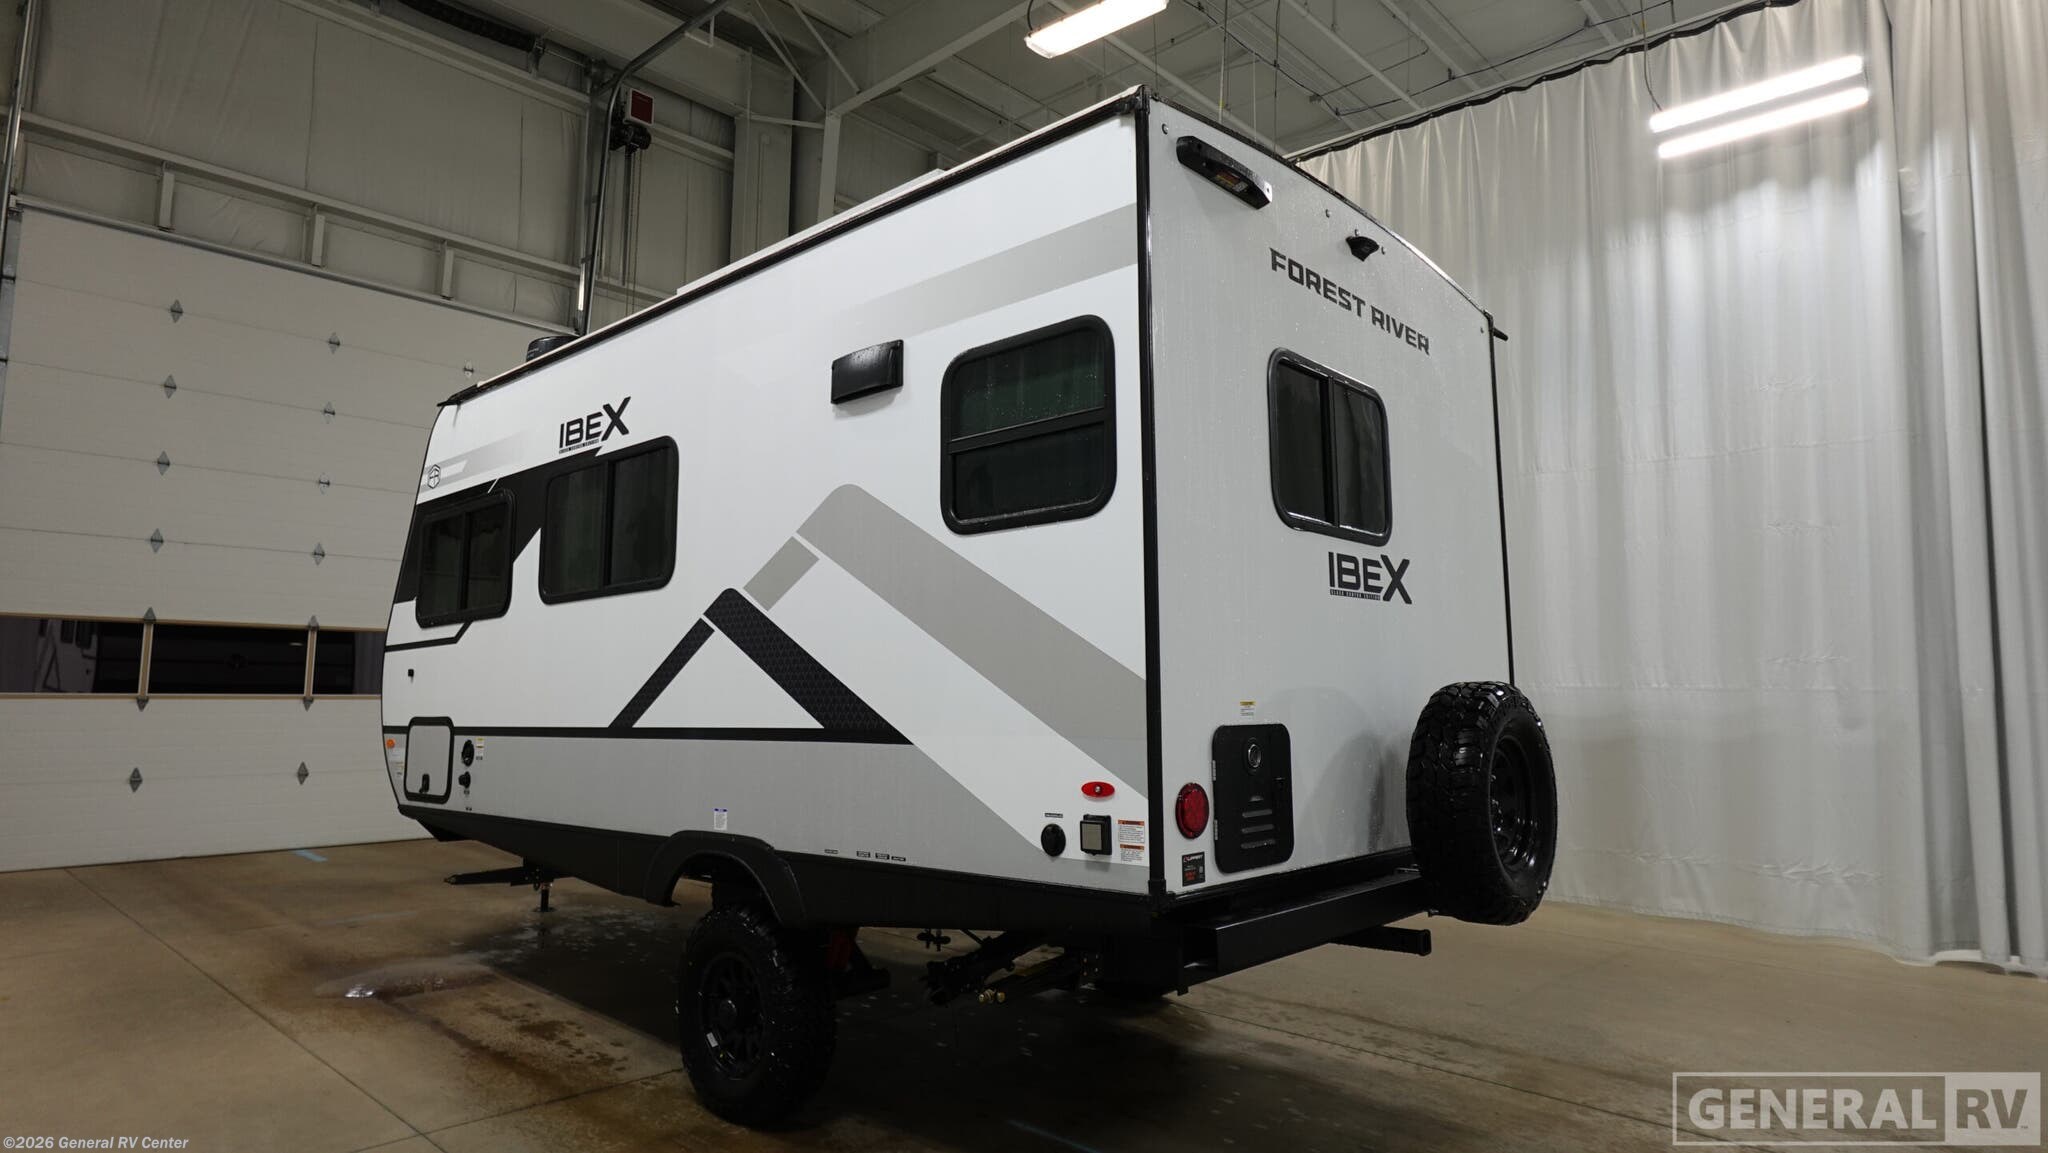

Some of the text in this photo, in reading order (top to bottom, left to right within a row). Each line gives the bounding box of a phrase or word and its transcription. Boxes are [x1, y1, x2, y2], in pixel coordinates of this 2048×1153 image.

[1269, 247, 1430, 356] FOREST RIVER
[559, 396, 632, 448] IBEX
[1327, 551, 1413, 605] IBEX
